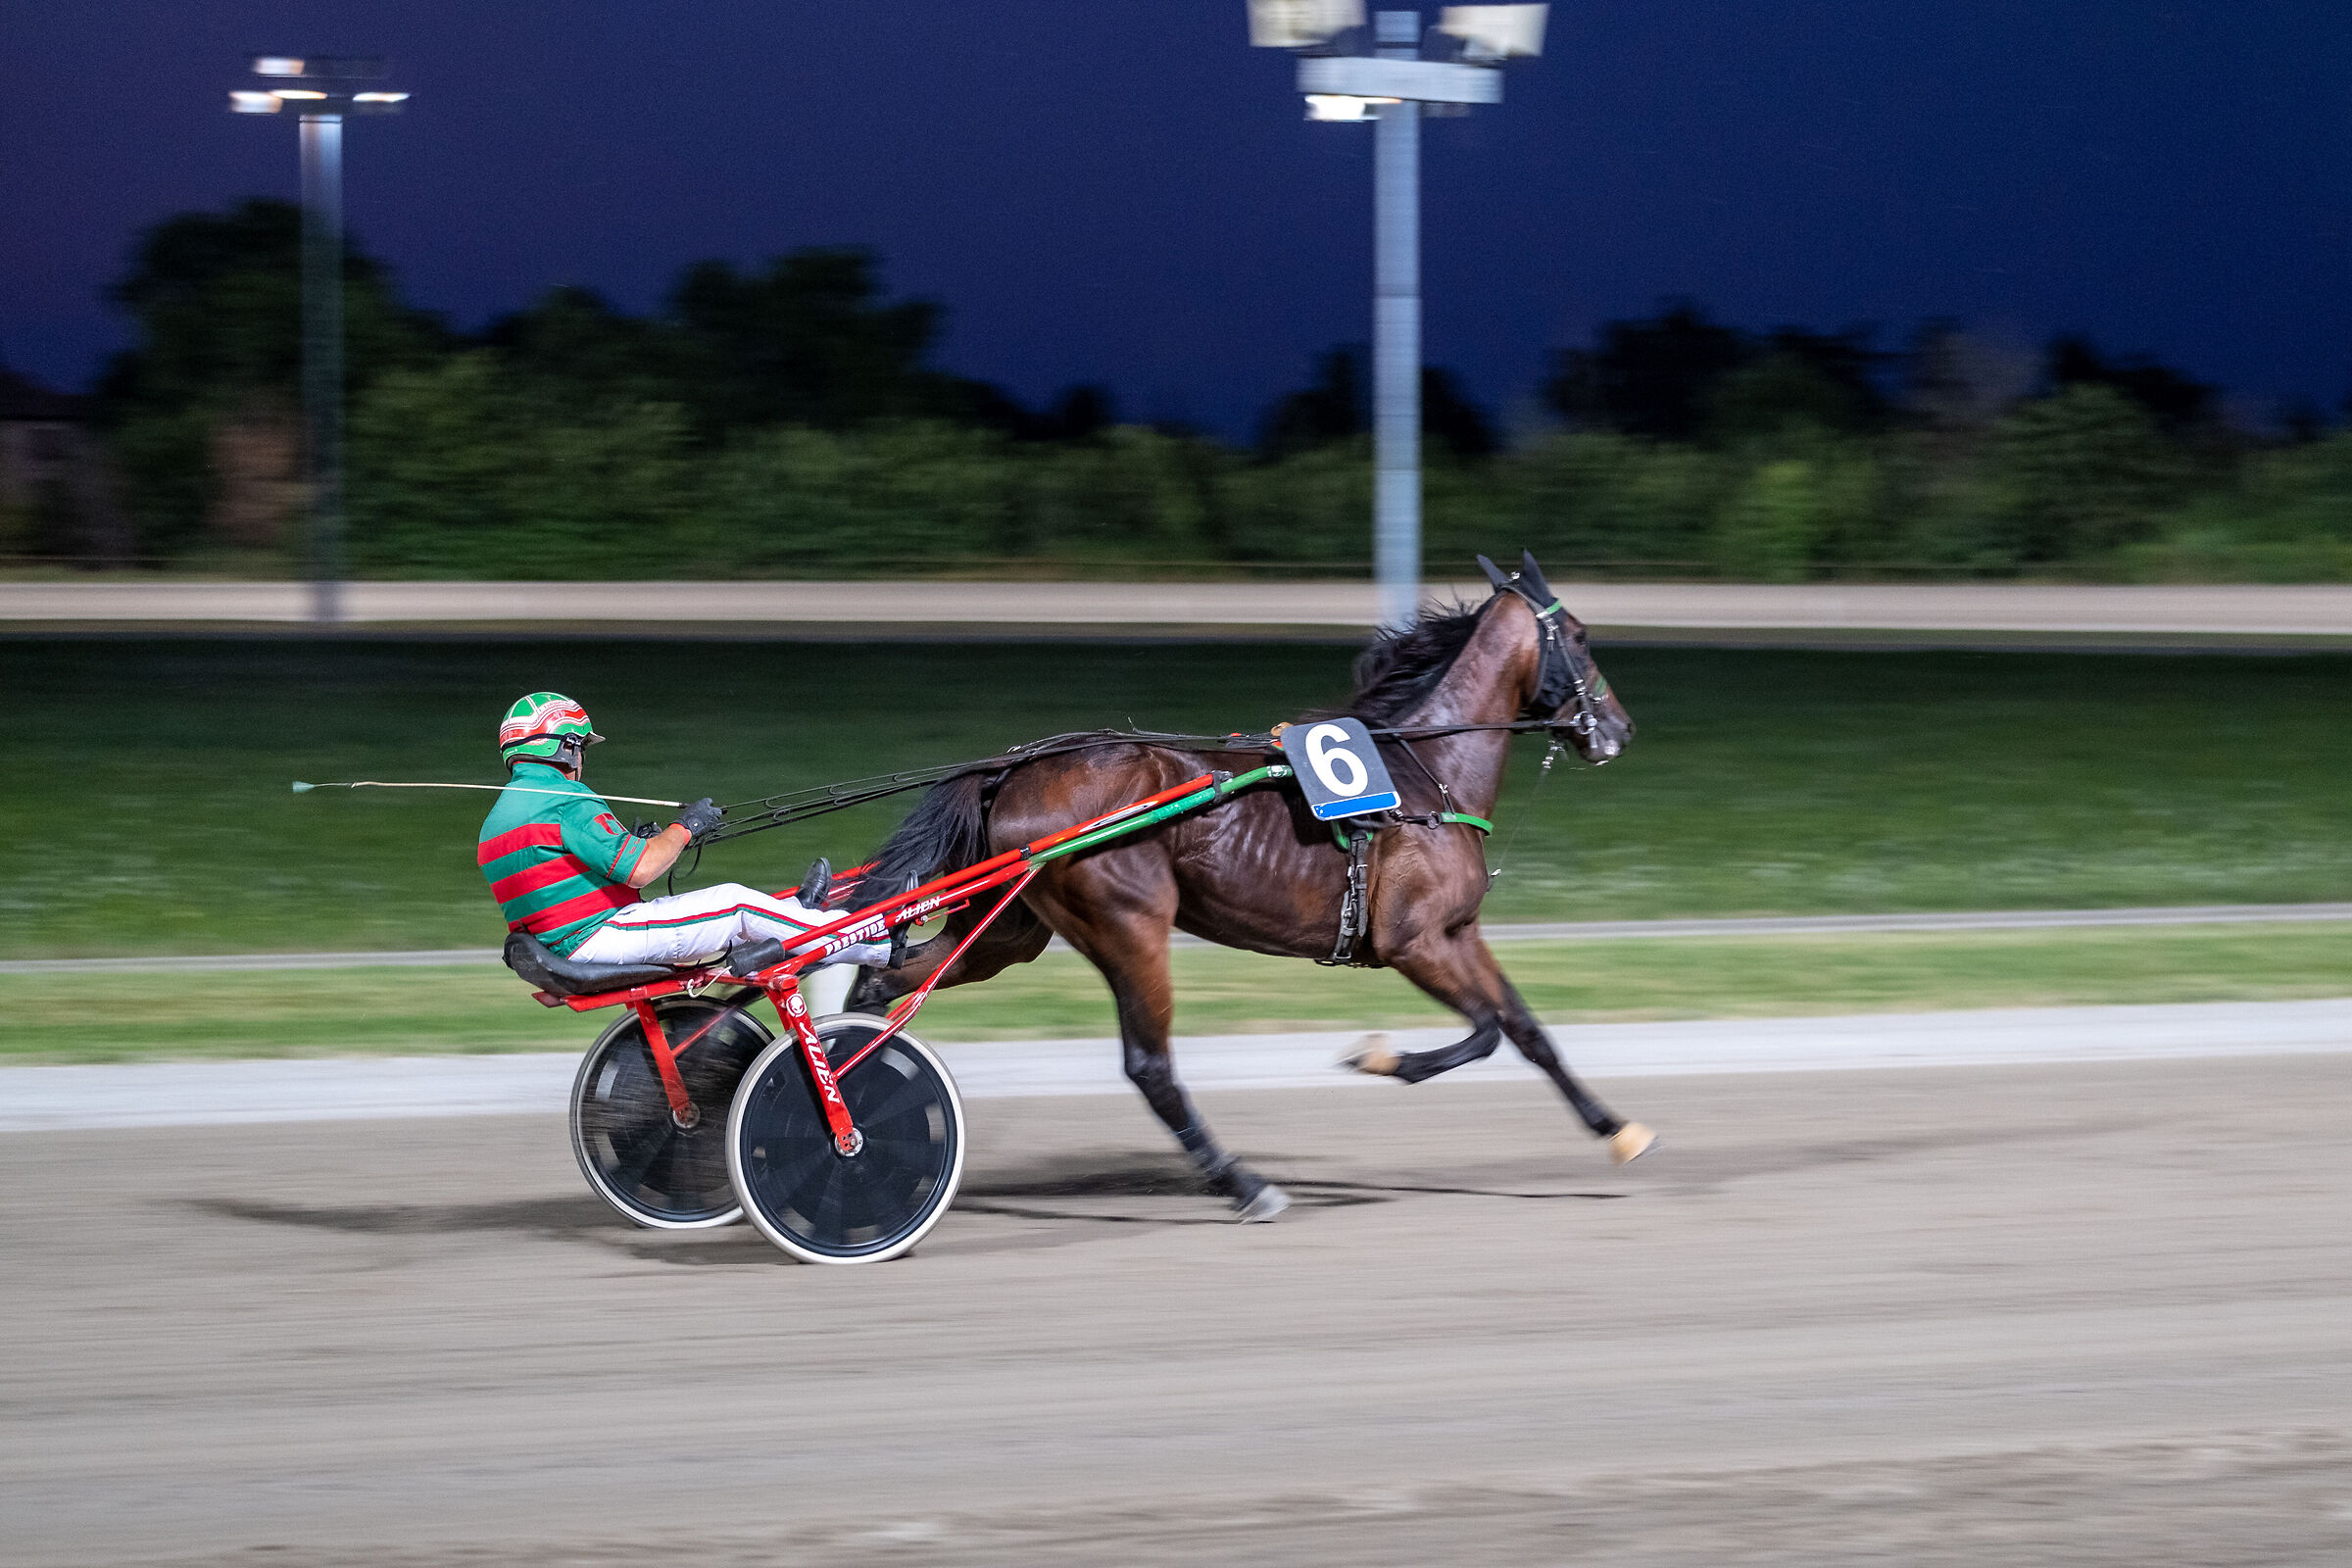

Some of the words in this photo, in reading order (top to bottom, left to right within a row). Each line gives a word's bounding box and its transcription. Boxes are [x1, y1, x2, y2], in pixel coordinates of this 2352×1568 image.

[1305, 723, 1368, 797] 6
[895, 896, 941, 923] ALIEN
[800, 1021, 840, 1103] ALIEN
